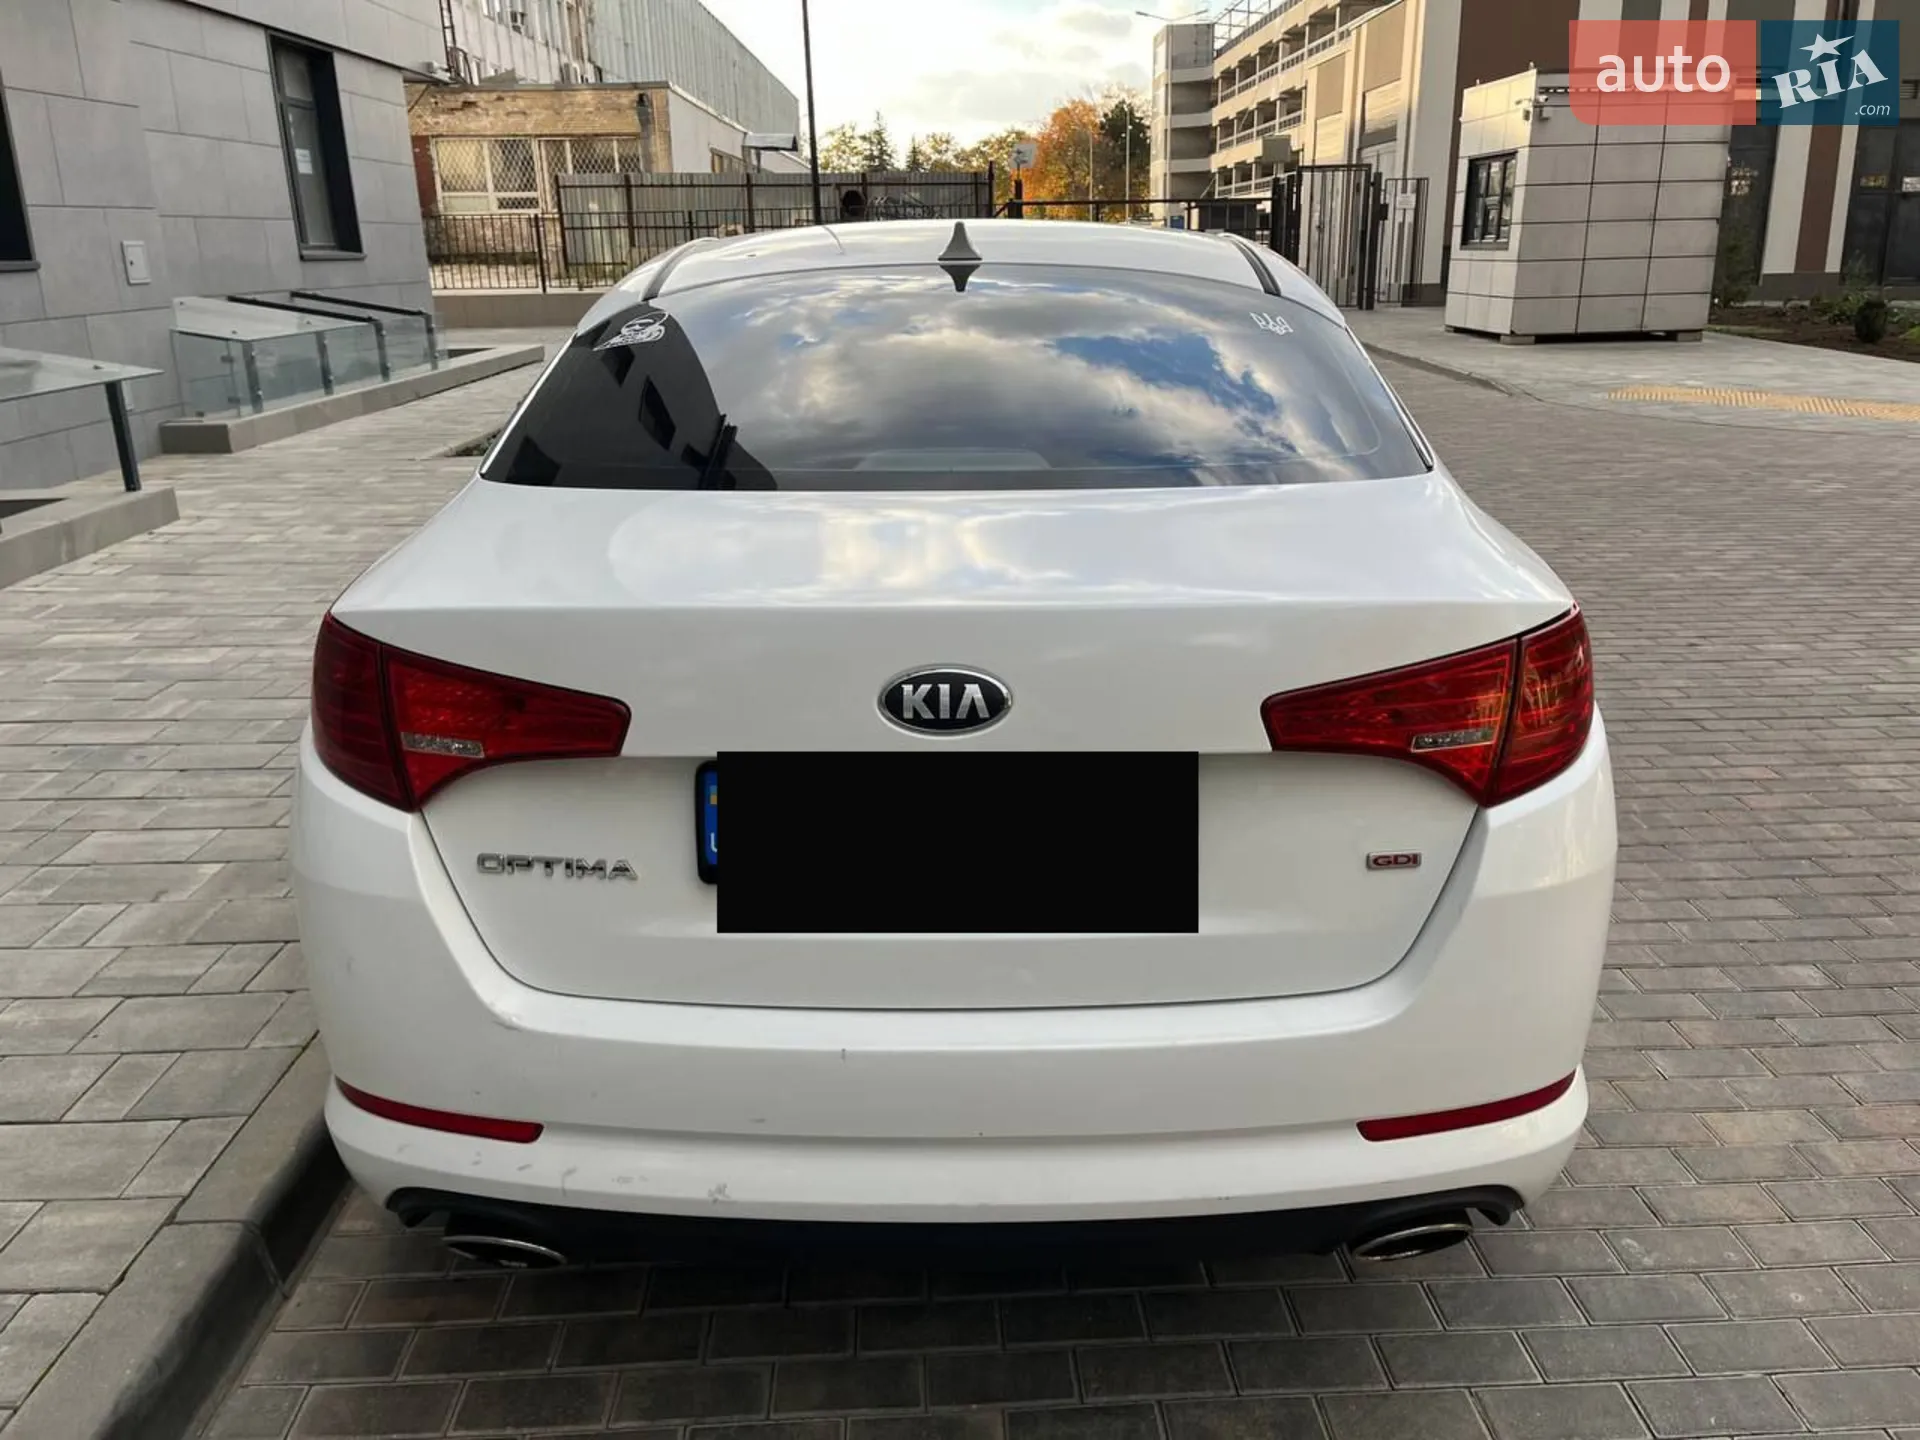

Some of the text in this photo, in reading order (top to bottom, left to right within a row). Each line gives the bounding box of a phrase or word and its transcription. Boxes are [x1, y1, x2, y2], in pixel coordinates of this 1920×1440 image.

[901, 683, 990, 719] KIA
[477, 852, 638, 881] OPTIMA
[1373, 854, 1418, 866] GDI
